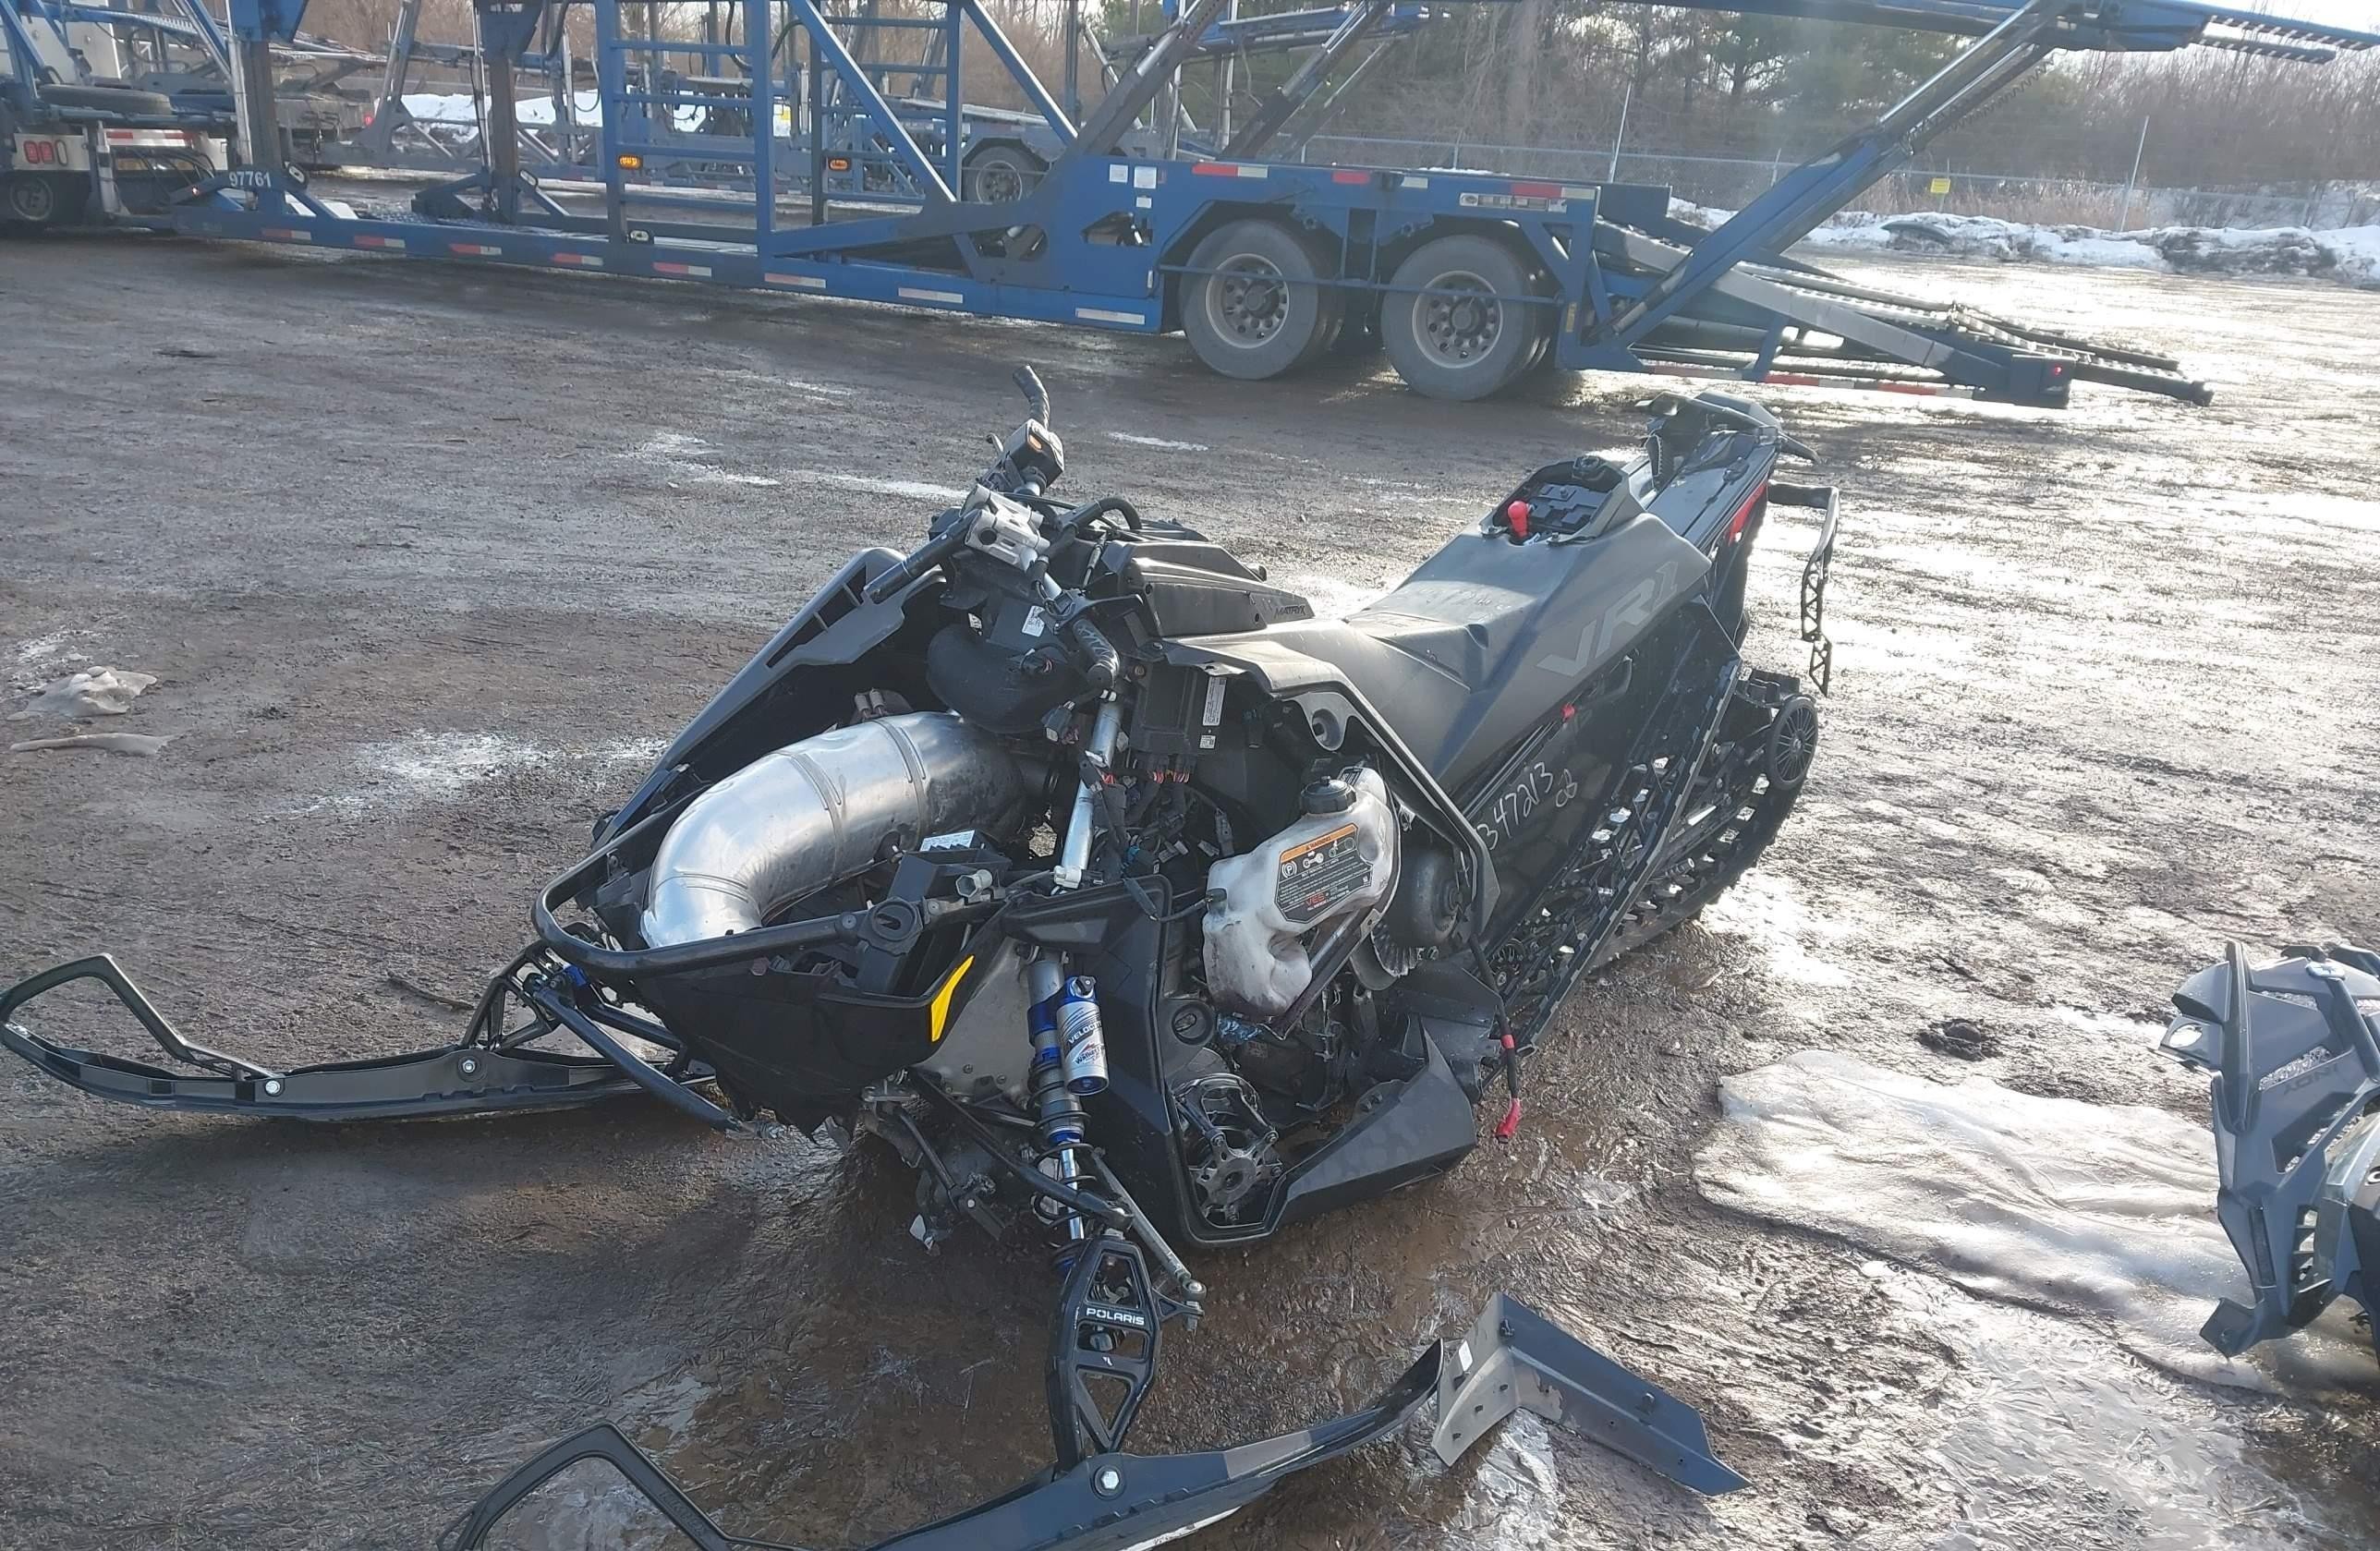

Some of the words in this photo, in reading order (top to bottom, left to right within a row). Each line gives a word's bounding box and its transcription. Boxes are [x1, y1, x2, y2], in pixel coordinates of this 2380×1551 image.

[228, 170, 273, 188] 97761
[1536, 561, 1679, 677] VR1
[1476, 761, 1553, 851] 347213
[1086, 1307, 1145, 1327] POLARIS
